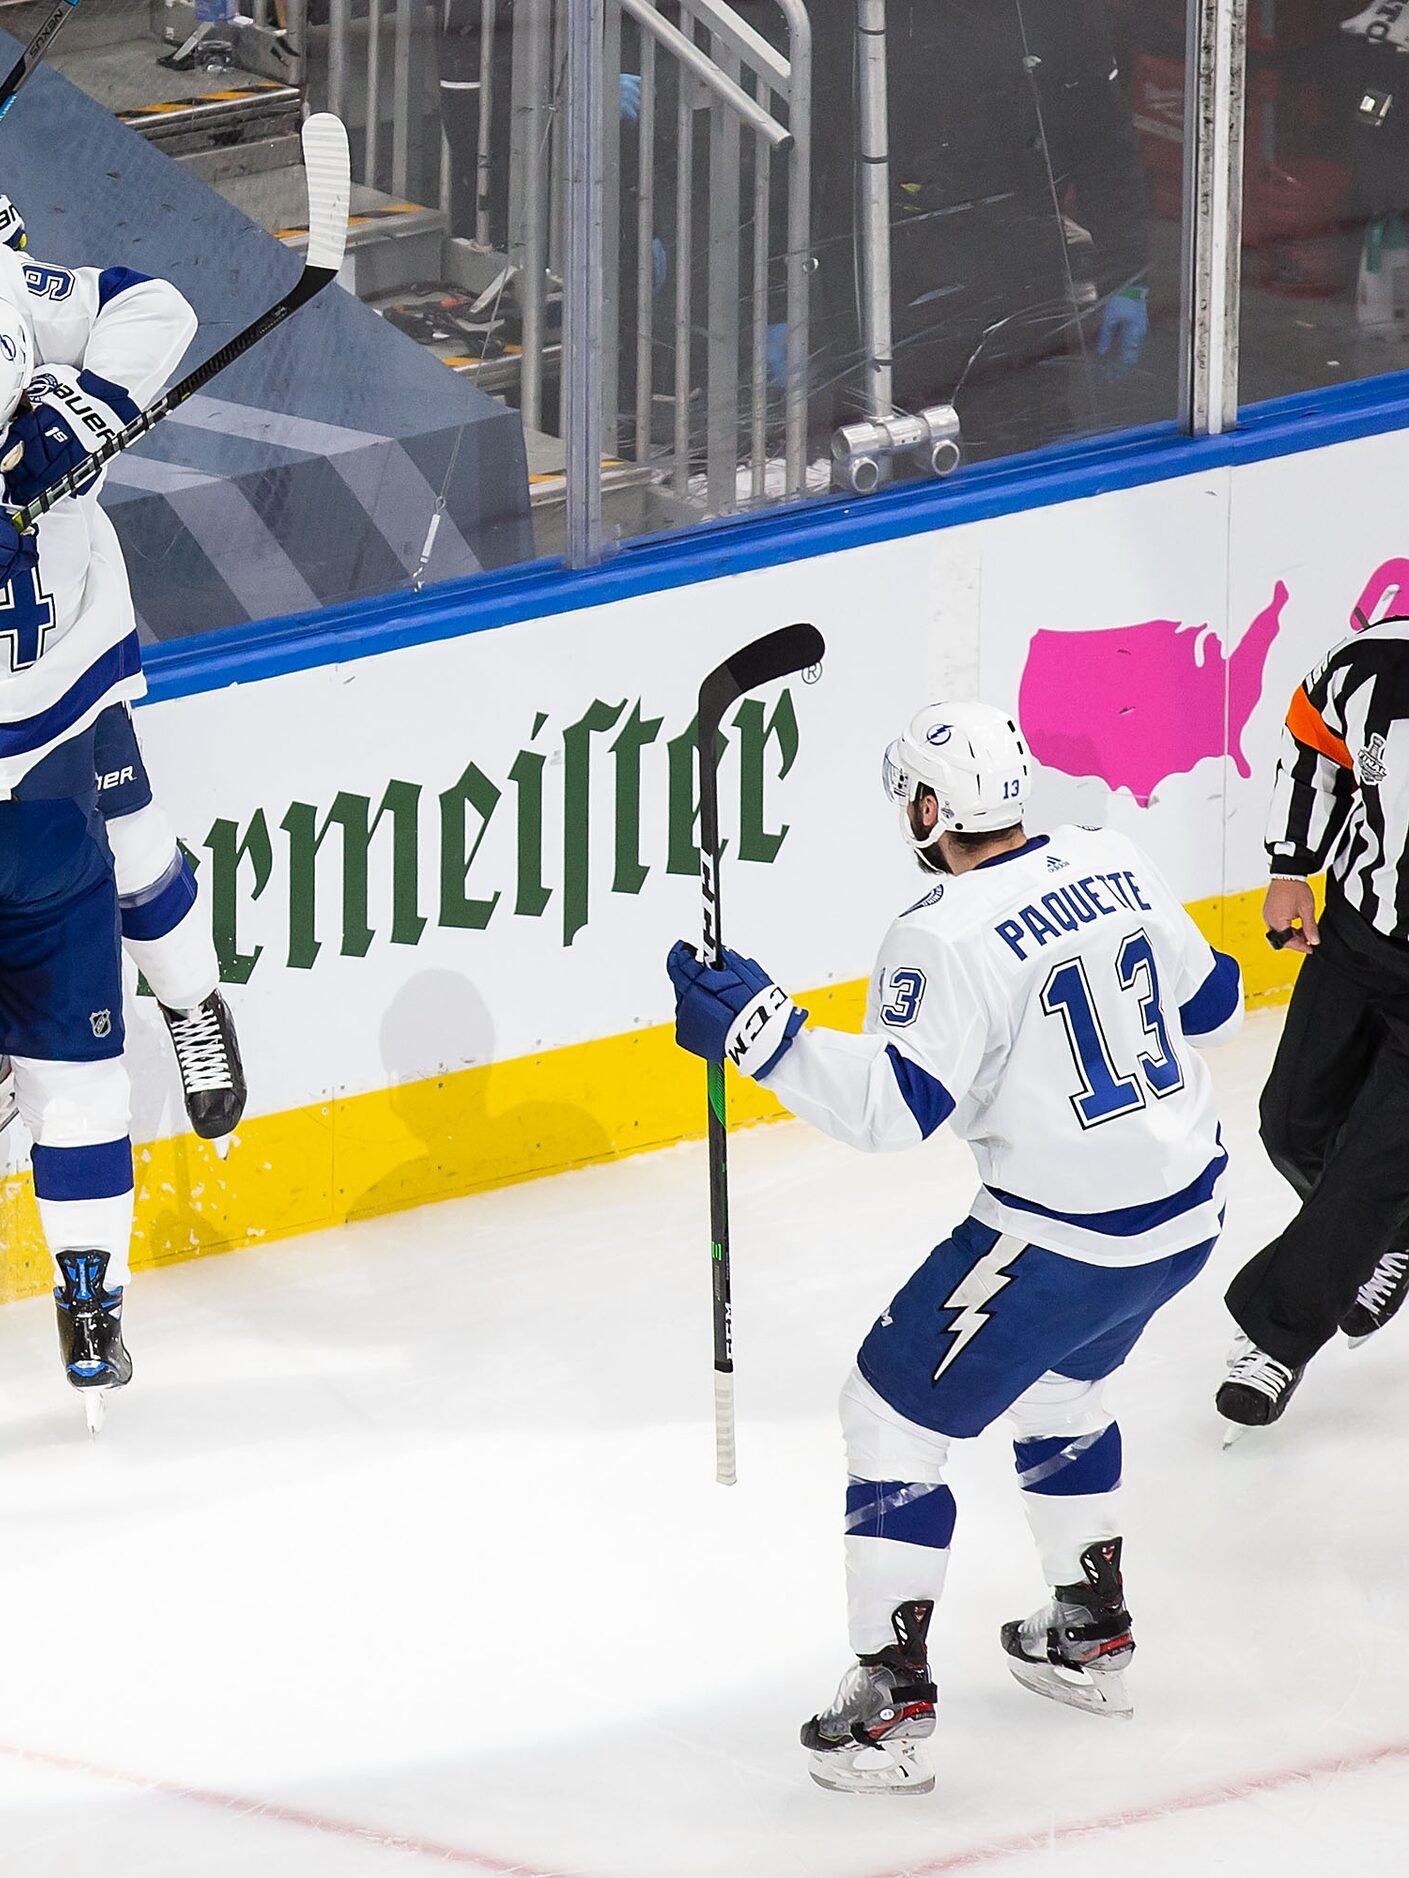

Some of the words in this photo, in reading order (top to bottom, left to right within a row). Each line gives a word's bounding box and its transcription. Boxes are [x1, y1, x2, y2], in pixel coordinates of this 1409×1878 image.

[1002, 779, 1021, 800] 13
[993, 870, 1152, 962] PAQUETTE
[728, 986, 789, 1067] CCM
[878, 966, 927, 1028] 3
[1038, 926, 1185, 1131] 13
